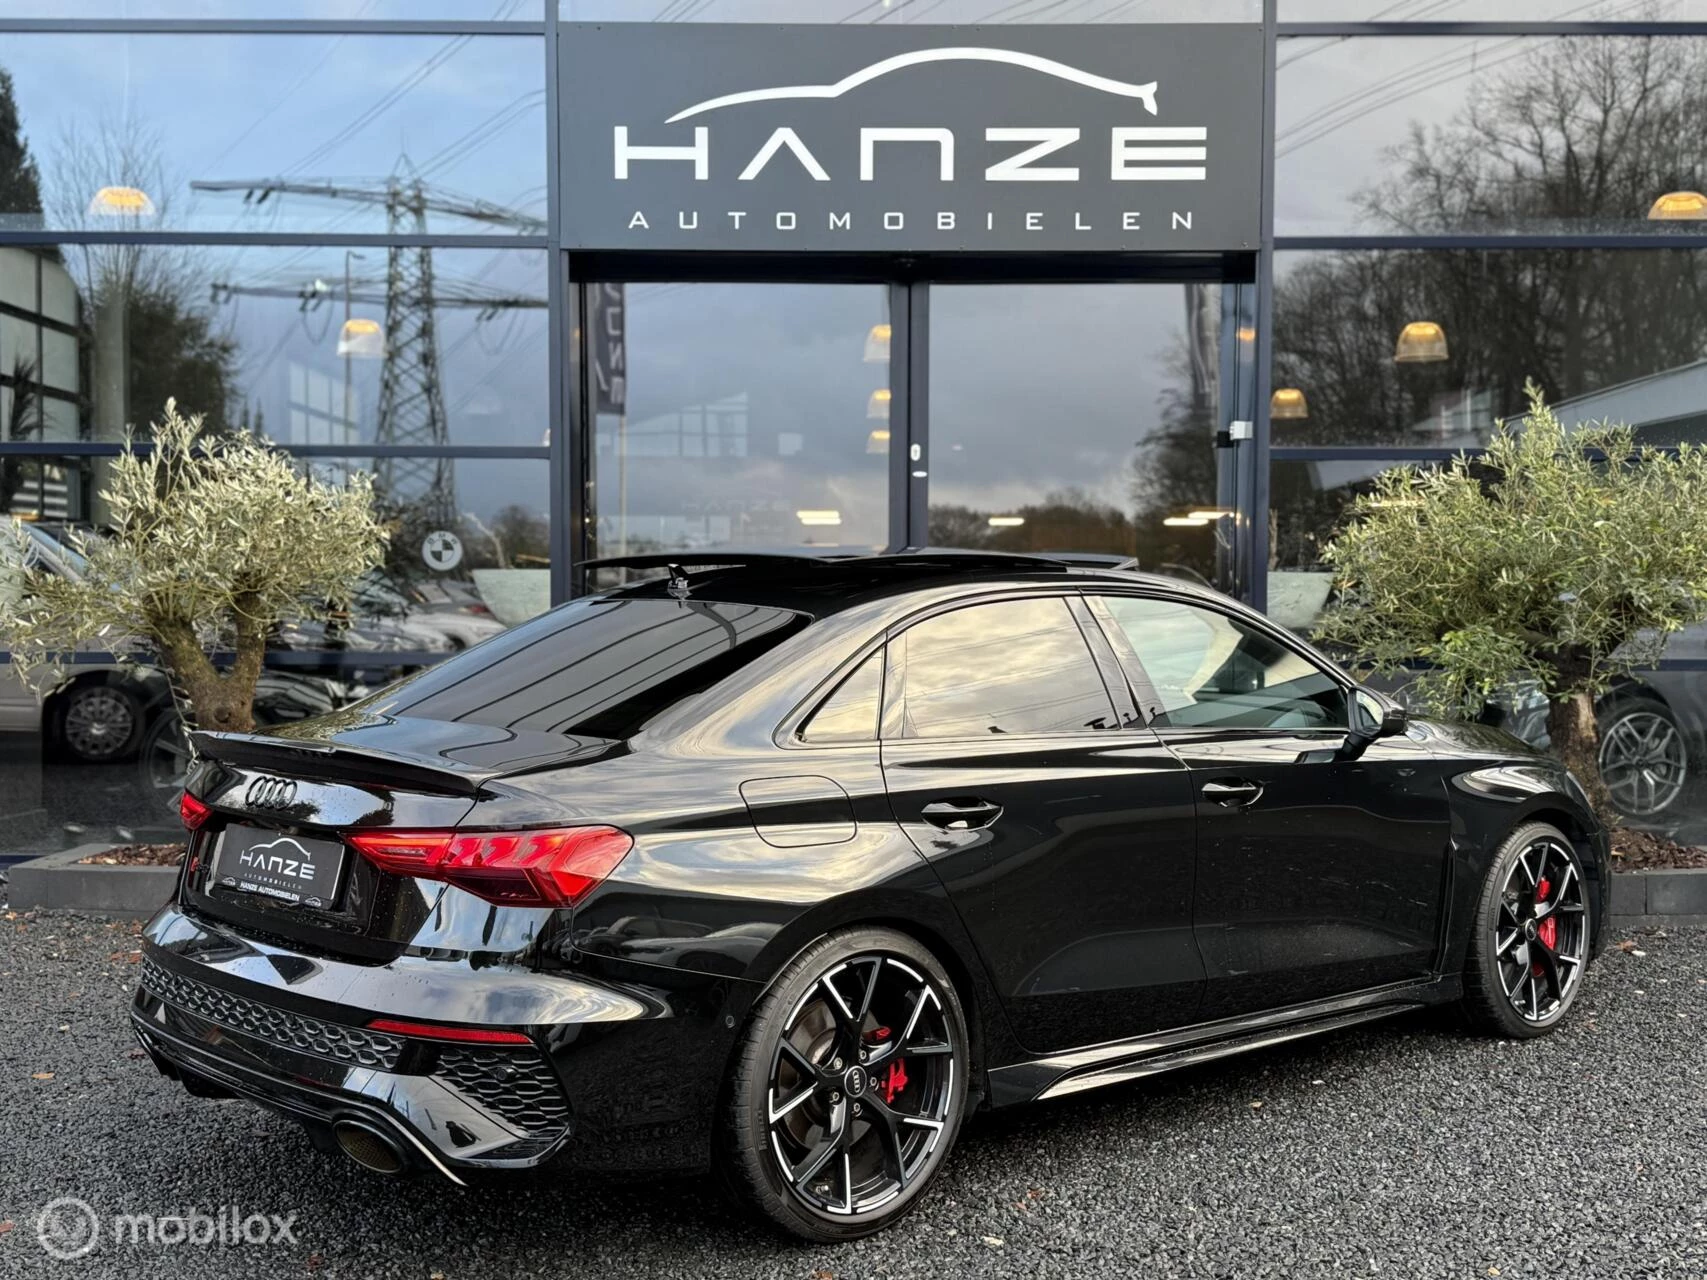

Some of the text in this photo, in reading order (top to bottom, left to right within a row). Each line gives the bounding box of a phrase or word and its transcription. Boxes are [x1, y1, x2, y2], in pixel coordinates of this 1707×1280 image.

[613, 126, 1207, 181] HANZE
[629, 211, 1193, 230] AUTOMOBIELEN
[239, 850, 315, 880] HANZE
[240, 881, 258, 891] HANZE
[258, 886, 300, 902] AUTOMOBIELEN
